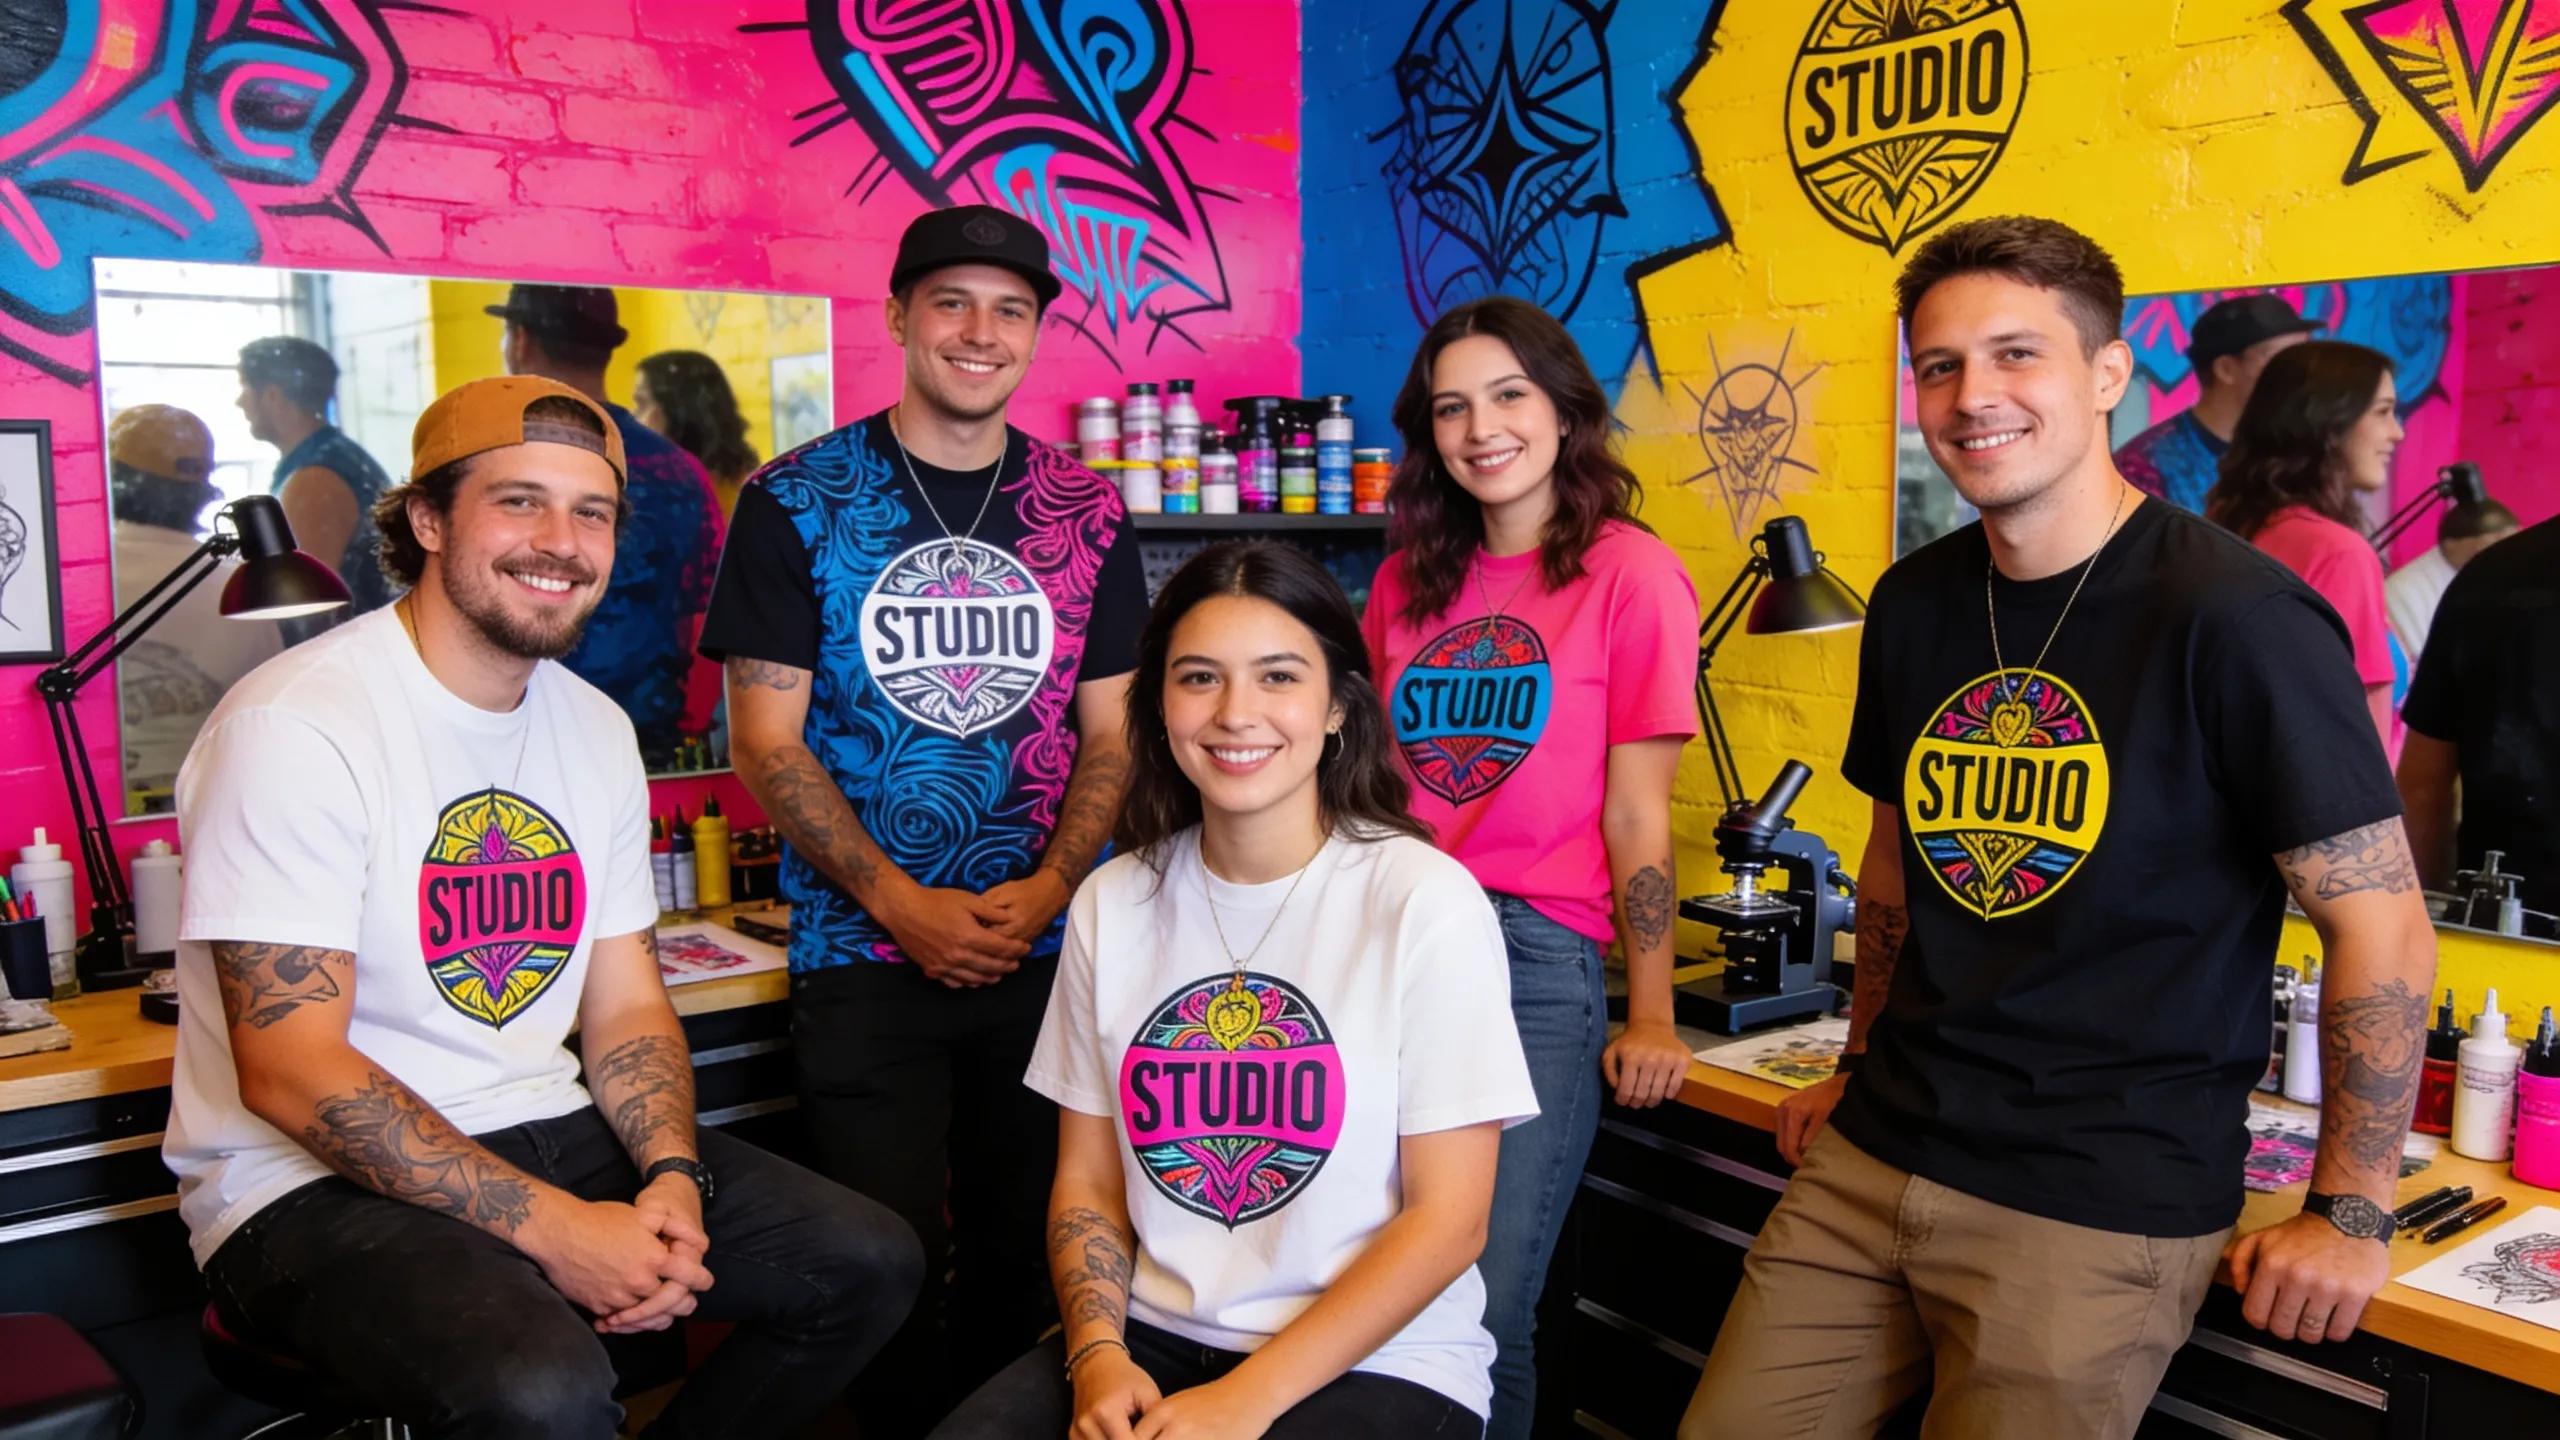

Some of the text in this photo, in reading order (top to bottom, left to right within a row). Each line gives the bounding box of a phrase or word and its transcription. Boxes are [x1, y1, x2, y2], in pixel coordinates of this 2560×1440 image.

[1805, 29, 2005, 149] STUDIO
[873, 604, 1040, 665] STUDIO
[1402, 675, 1538, 732] STUDIO
[1917, 750, 2090, 832] STUDIO
[427, 868, 573, 946] STUDIO
[1130, 1060, 1327, 1132] STUDIO
